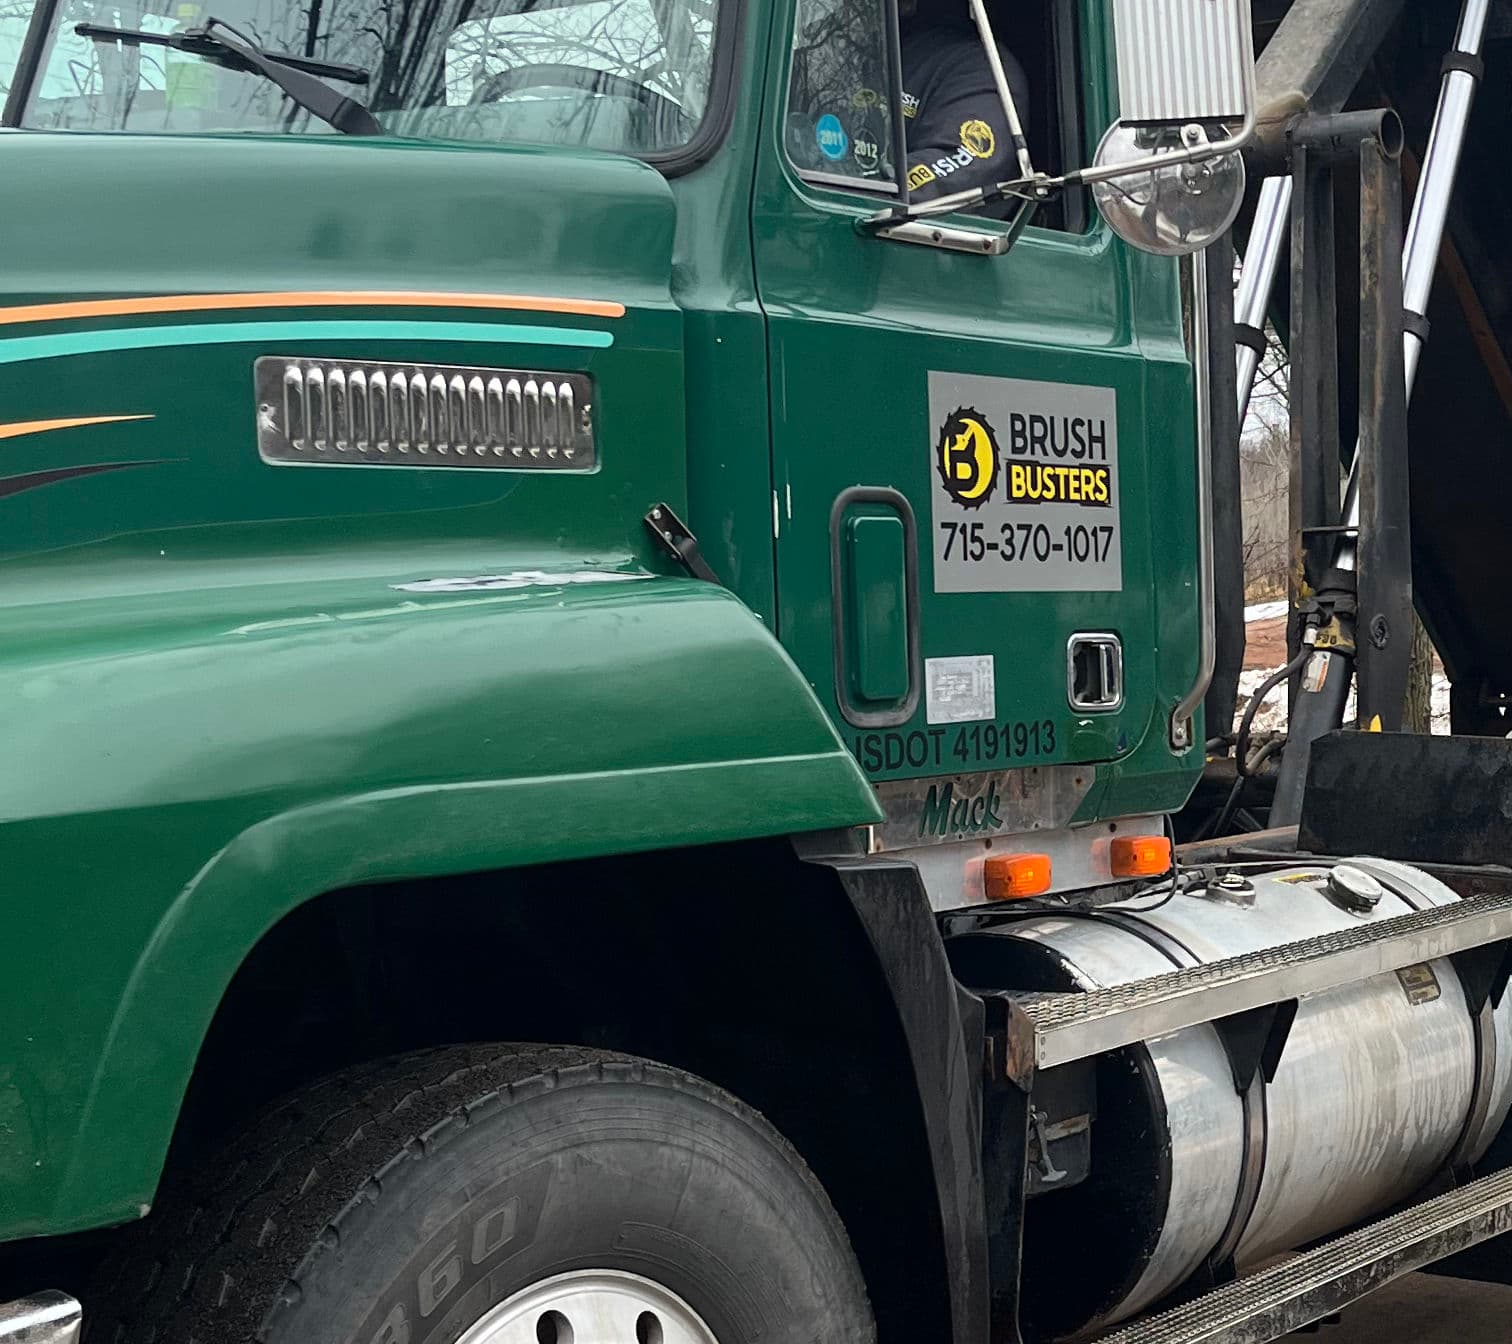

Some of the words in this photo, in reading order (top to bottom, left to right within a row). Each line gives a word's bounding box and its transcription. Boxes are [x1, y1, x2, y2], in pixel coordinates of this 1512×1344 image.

[854, 140, 877, 159] 2012
[1010, 413, 1106, 460] BRUSH
[1011, 464, 1108, 502] BUSTERS
[941, 522, 1113, 562] 715-370-1017
[953, 719, 1056, 762] 4191913
[918, 780, 1003, 838] Mack
